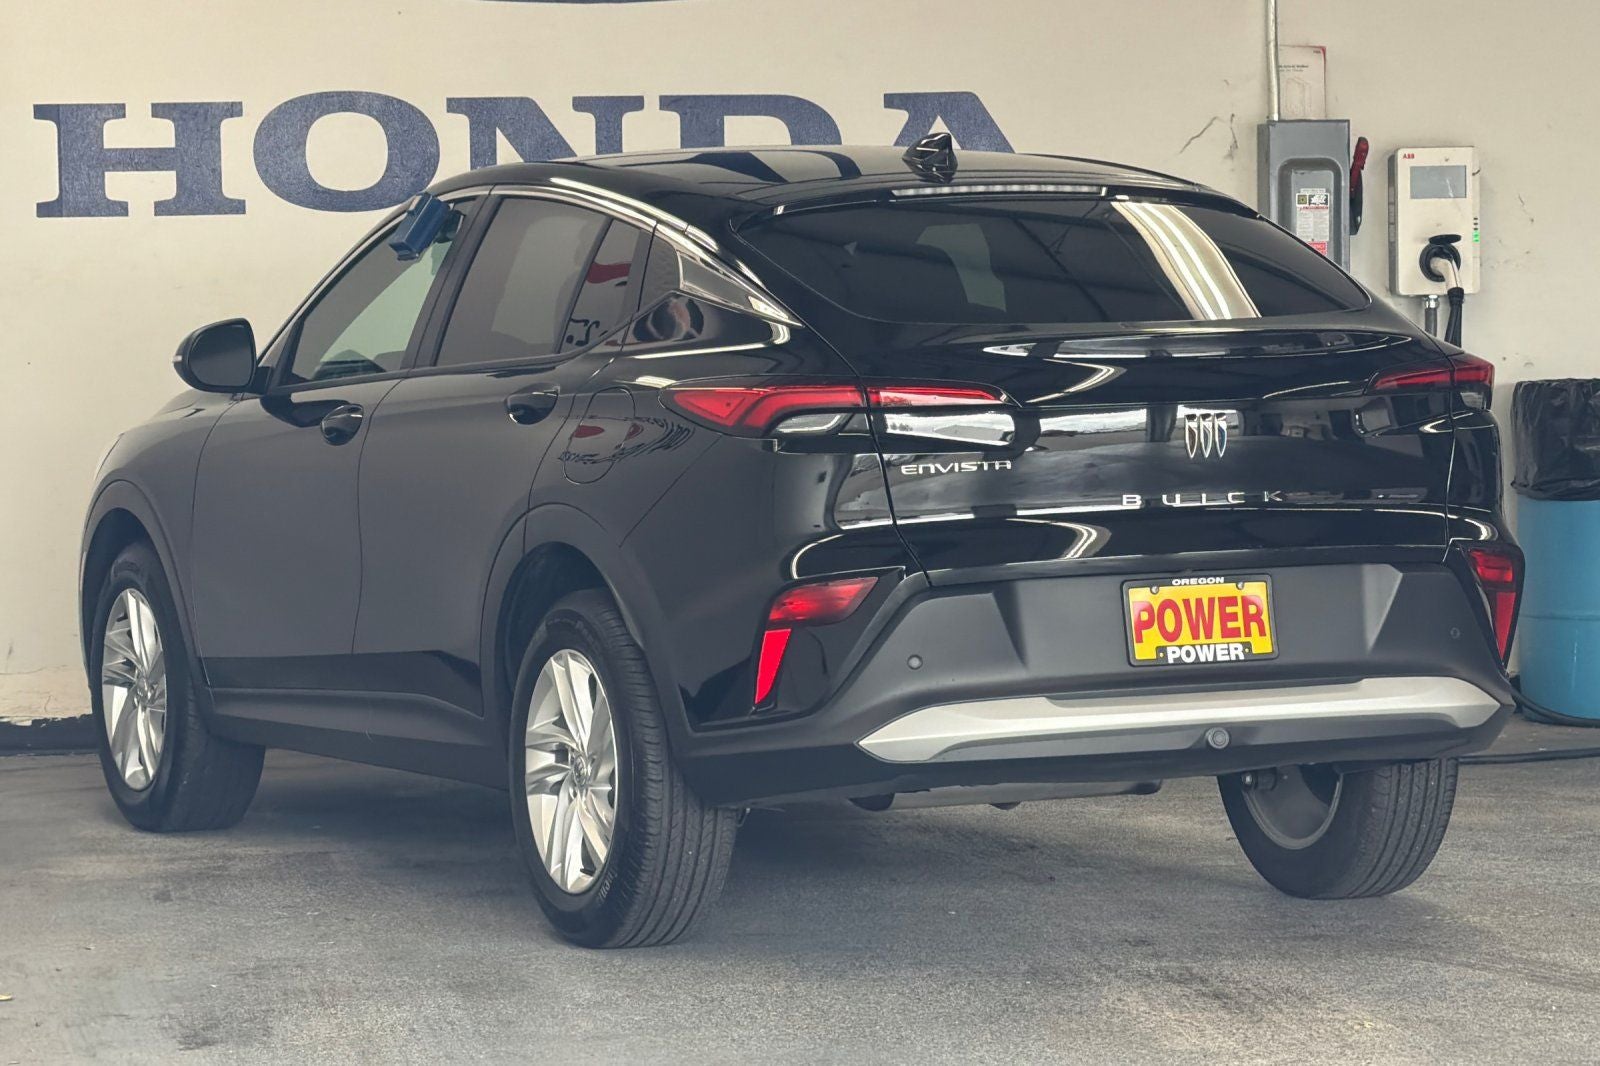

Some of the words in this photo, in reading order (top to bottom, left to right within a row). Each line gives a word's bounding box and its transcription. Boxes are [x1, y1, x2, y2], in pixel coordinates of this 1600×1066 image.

[901, 460, 1012, 475] ENVISTA
[1122, 491, 1283, 506] BUICK
[1171, 576, 1225, 586] OREGON
[1132, 595, 1267, 644] POWER
[1166, 643, 1245, 664] POWER
